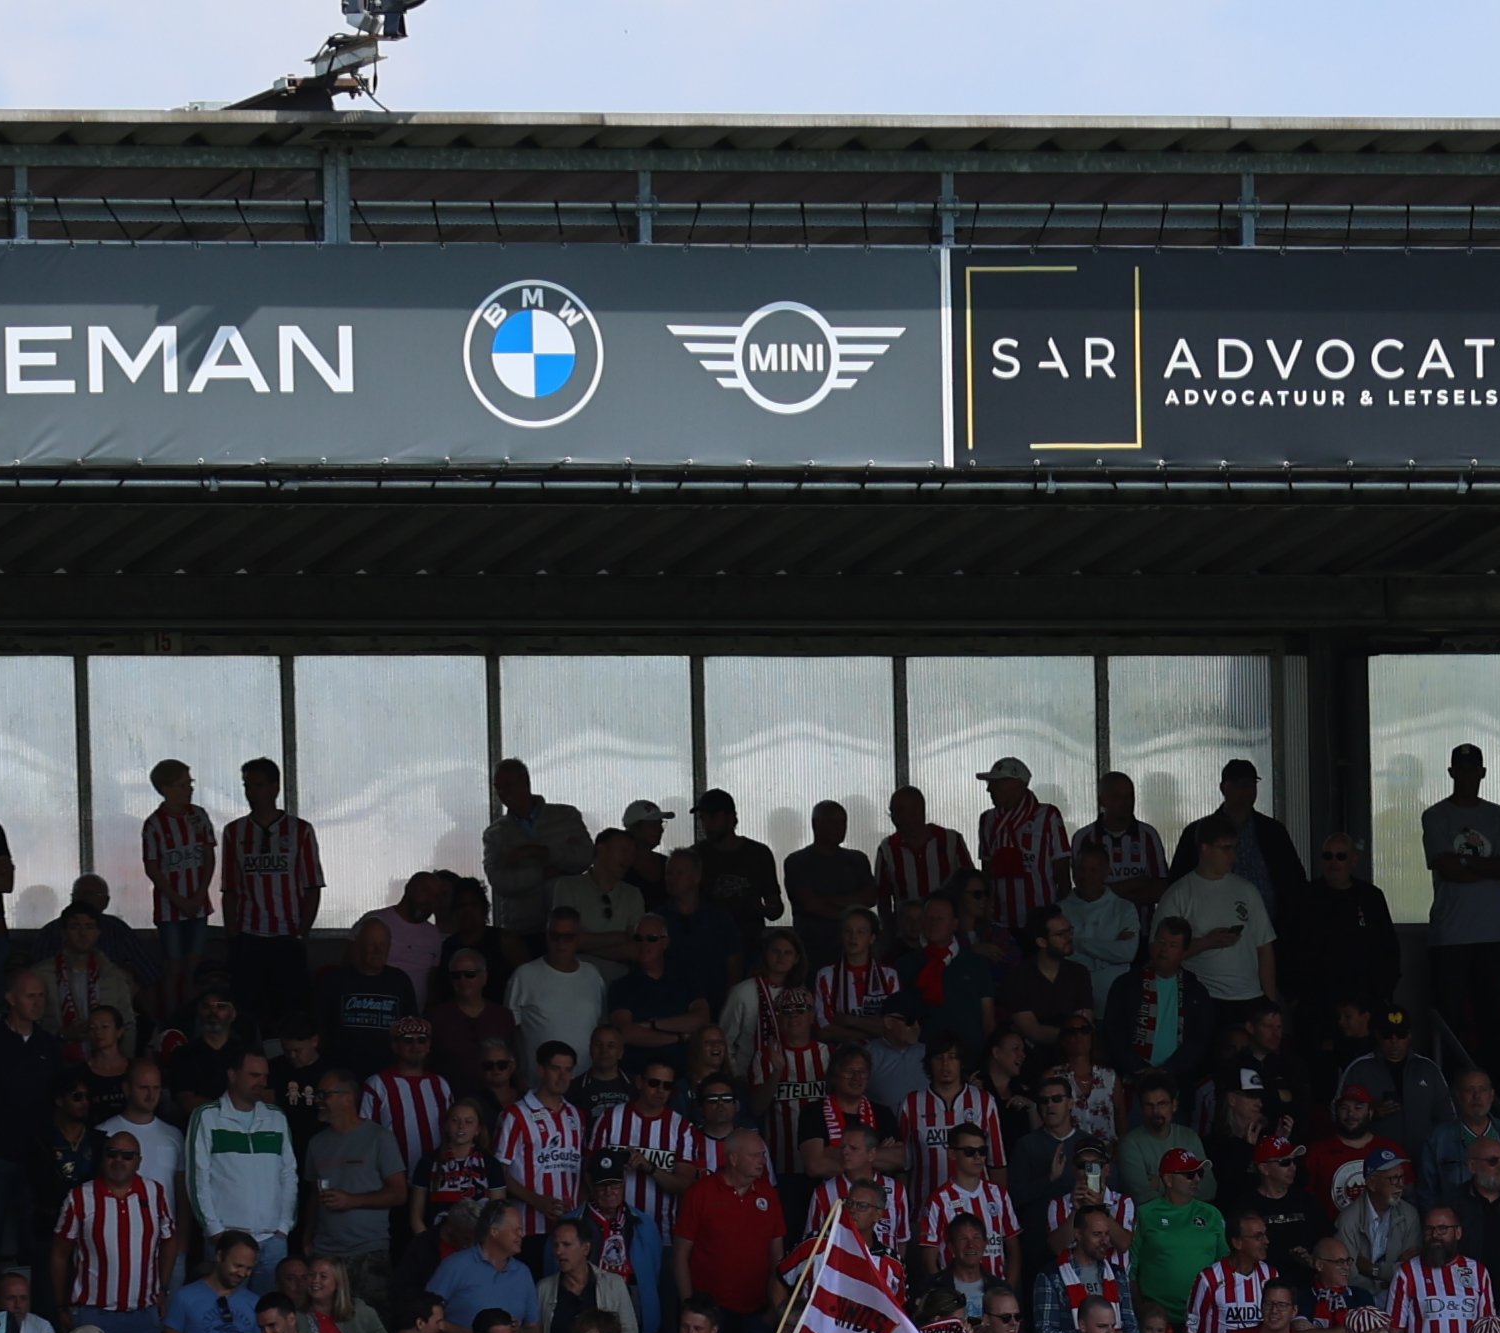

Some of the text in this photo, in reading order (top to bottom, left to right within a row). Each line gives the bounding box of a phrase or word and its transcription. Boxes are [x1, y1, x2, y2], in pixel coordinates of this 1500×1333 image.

[485, 286, 582, 327] BMW
[749, 341, 824, 374] MINI
[991, 337, 1117, 380] SAR
[1164, 389, 1349, 407] ADVOCATUUR
[1359, 389, 1375, 407] &
[242, 853, 288, 869] AXIDUS
[344, 996, 397, 1012] Carhartt
